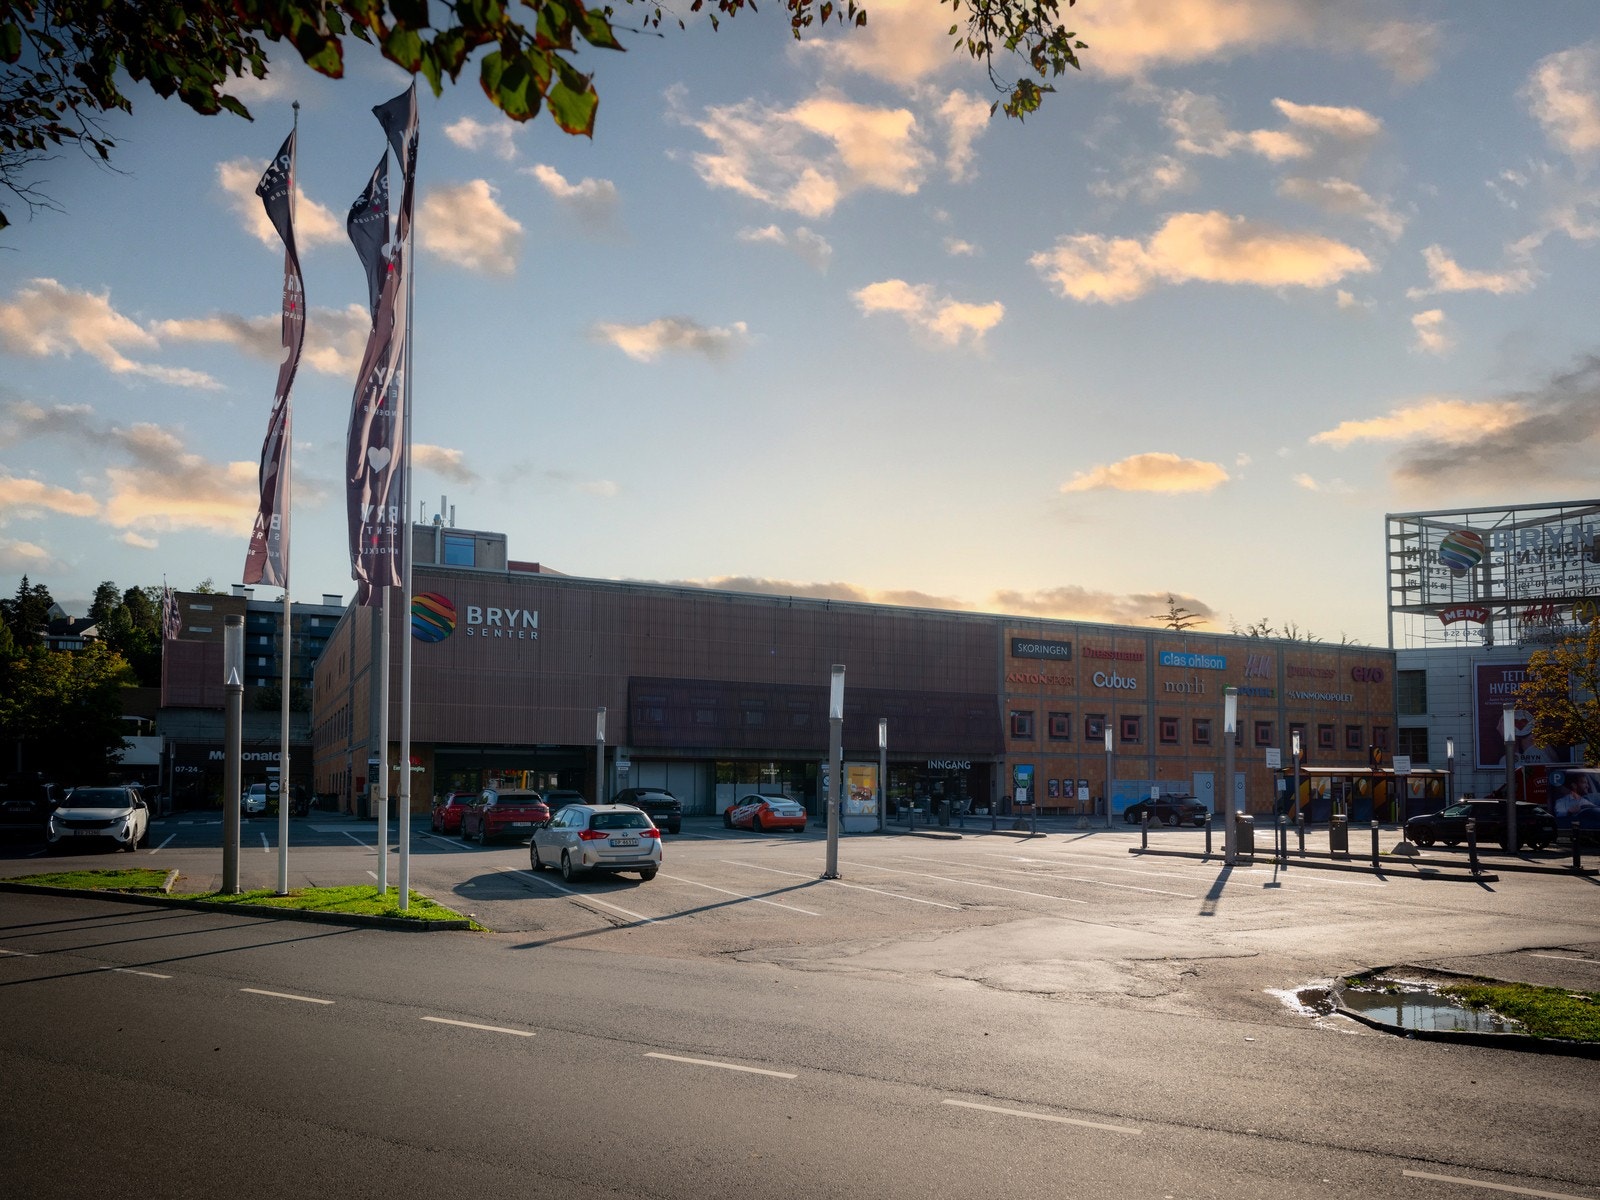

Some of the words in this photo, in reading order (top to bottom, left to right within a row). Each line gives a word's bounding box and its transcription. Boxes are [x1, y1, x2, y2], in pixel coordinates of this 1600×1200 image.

[1494, 525, 1594, 552] BRYN
[467, 605, 539, 629] BRYN
[1444, 609, 1485, 621] MENY
[467, 627, 539, 640] SENTER
[1018, 643, 1068, 655] SKORINGEN
[1163, 652, 1187, 666] clas
[1188, 654, 1223, 669] ohlson
[1093, 670, 1137, 690] Cubus
[1501, 670, 1526, 682] TETT
[1164, 676, 1206, 695] norli
[1295, 691, 1354, 702] VINMONOPOLET
[927, 759, 971, 770] INNGANG
